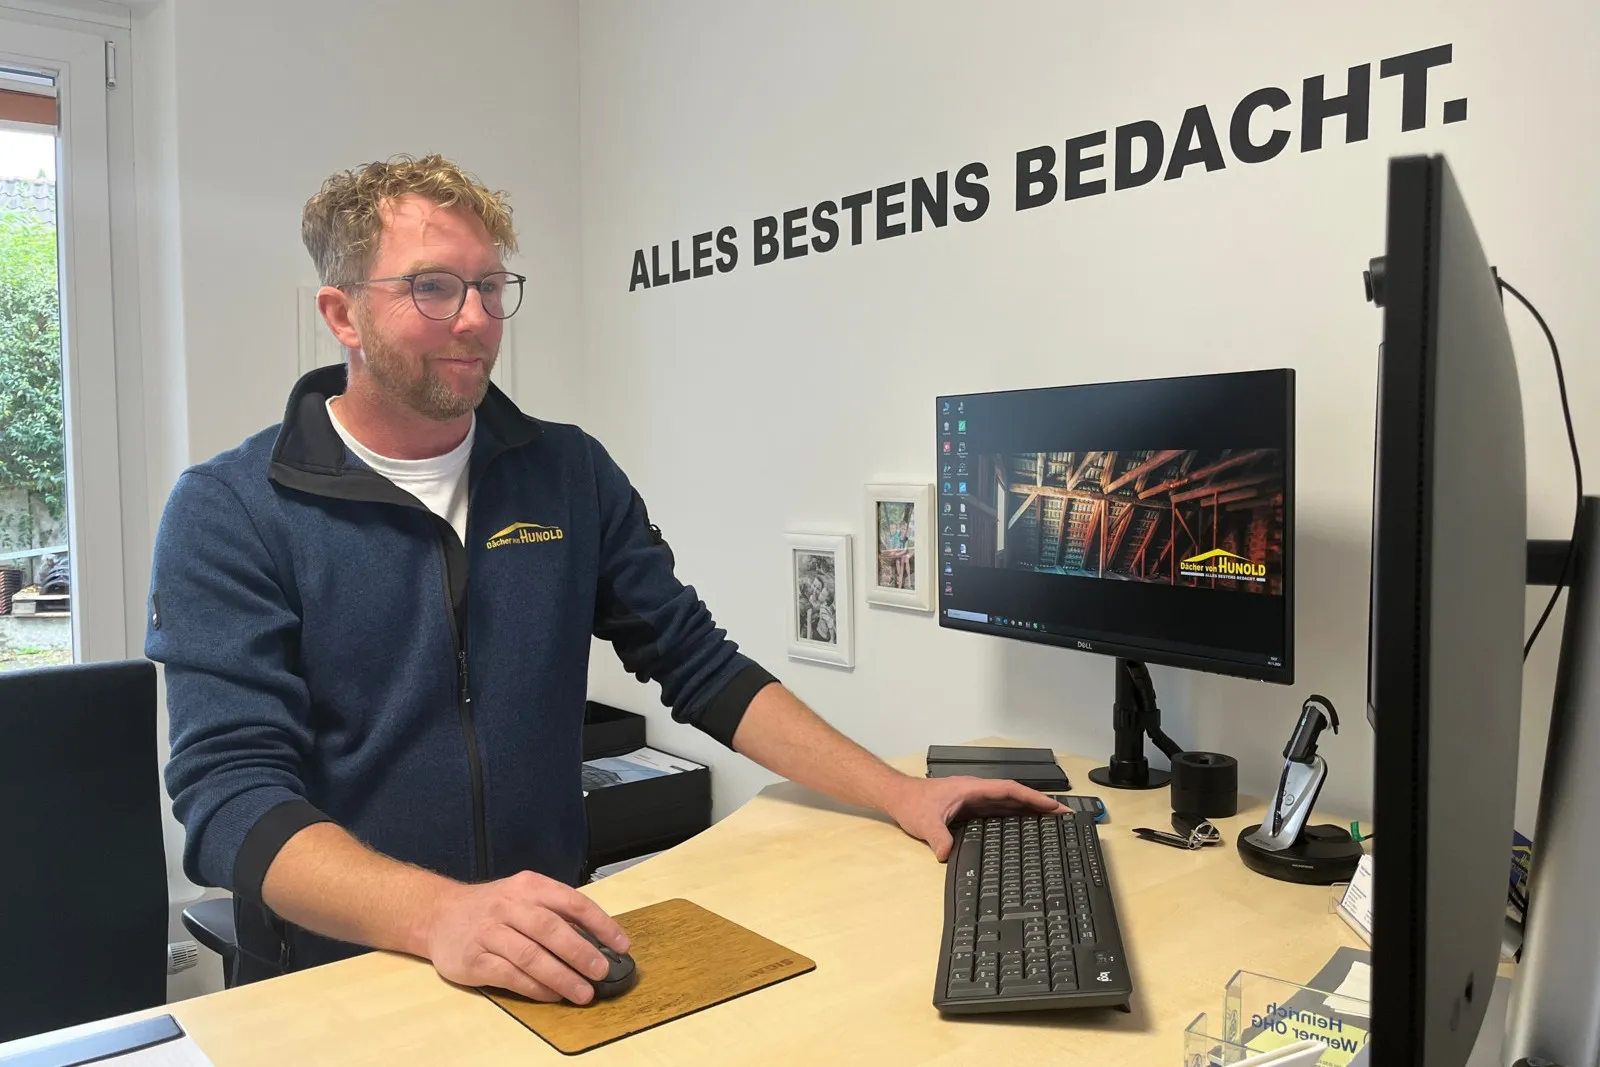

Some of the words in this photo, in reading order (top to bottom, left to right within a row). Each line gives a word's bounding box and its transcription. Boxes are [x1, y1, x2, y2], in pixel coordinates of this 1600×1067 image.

[629, 224, 737, 292] ALLES
[753, 161, 990, 267] BESTENS
[1016, 43, 1468, 212] BEDACHT.
[519, 528, 563, 543] HUNOLD
[1181, 561, 1203, 572] Dächer
[1205, 565, 1217, 573] von
[1219, 557, 1265, 576] HUNOLD
[1077, 641, 1092, 650] DELL
